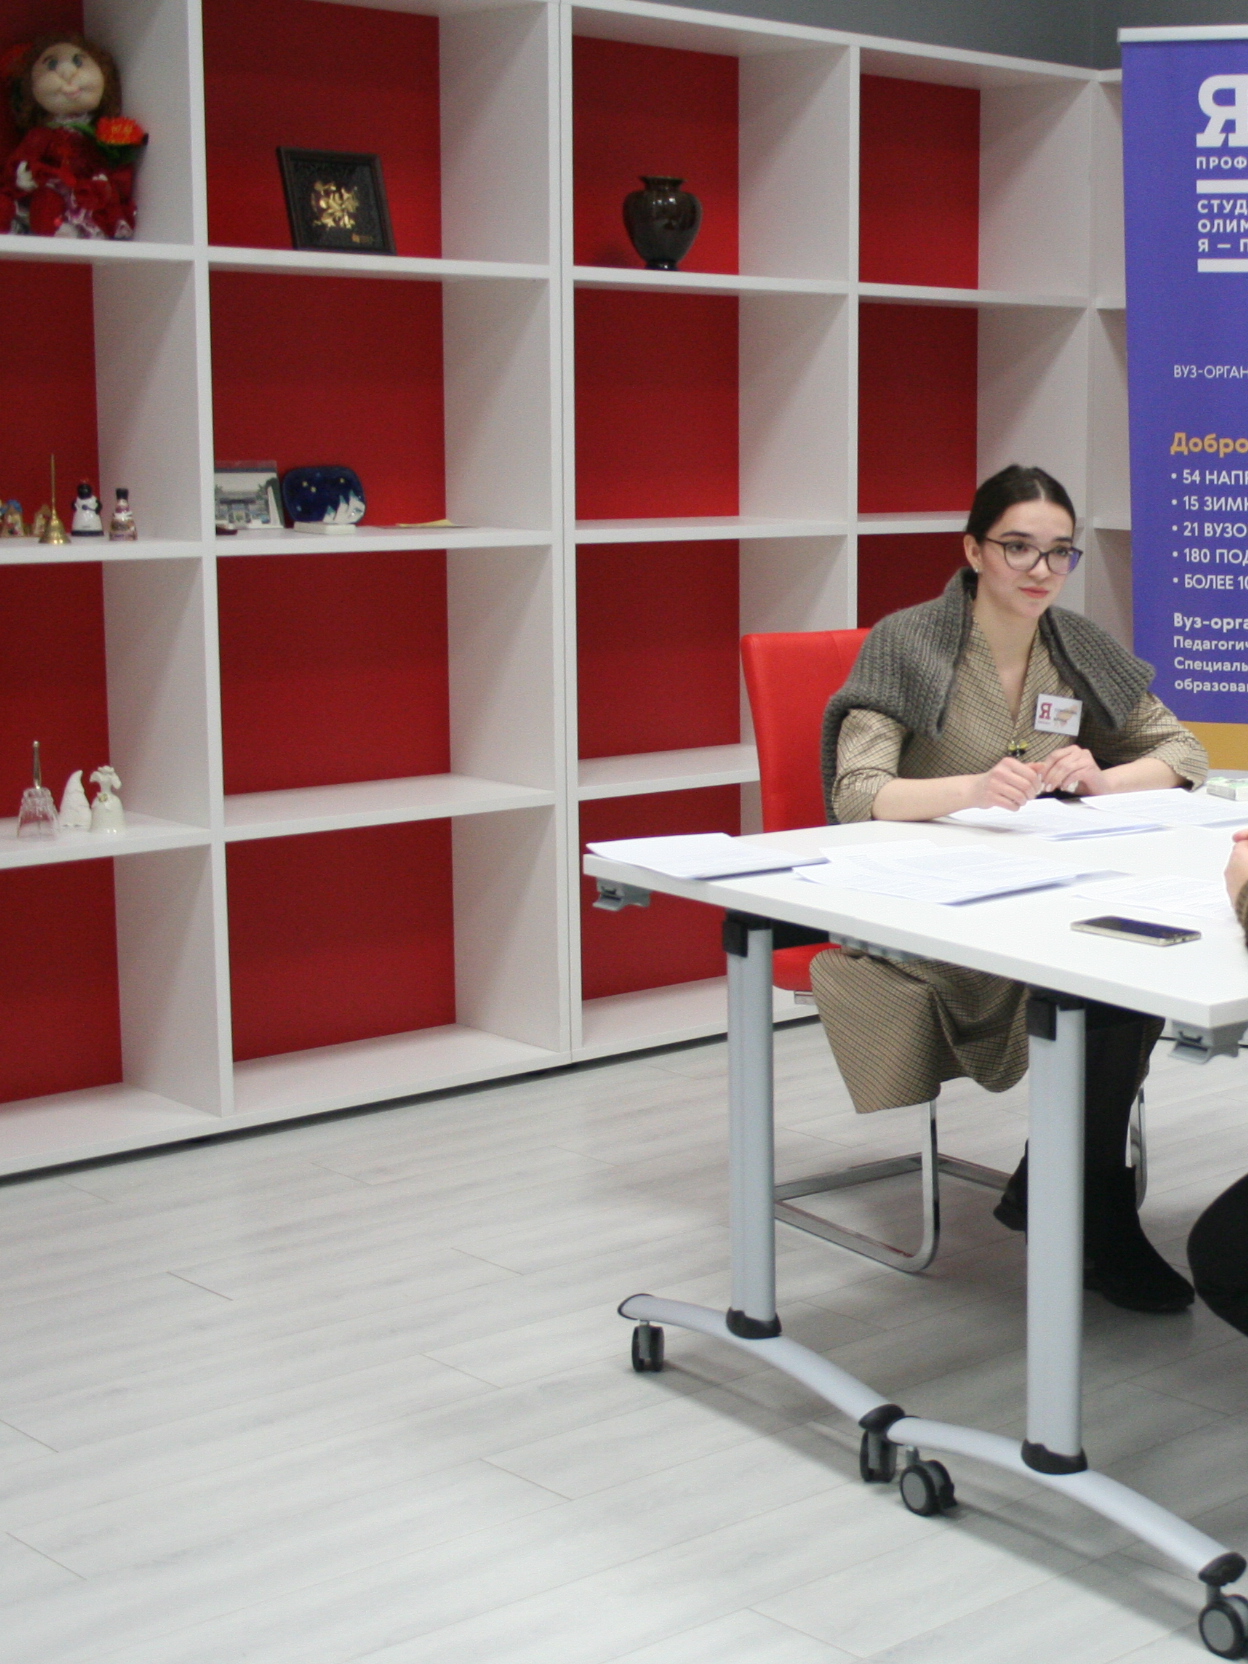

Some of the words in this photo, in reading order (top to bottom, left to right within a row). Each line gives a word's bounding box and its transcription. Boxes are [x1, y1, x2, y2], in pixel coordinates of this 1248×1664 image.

[1197, 239, 1209, 252] Я
[1183, 469, 1200, 484] 54
[1183, 496, 1199, 510] 15
[1183, 522, 1199, 536] 21
[1184, 548, 1210, 563] 180
[1184, 574, 1234, 589] БОЛЕЕ
[1039, 702, 1053, 719] Я
